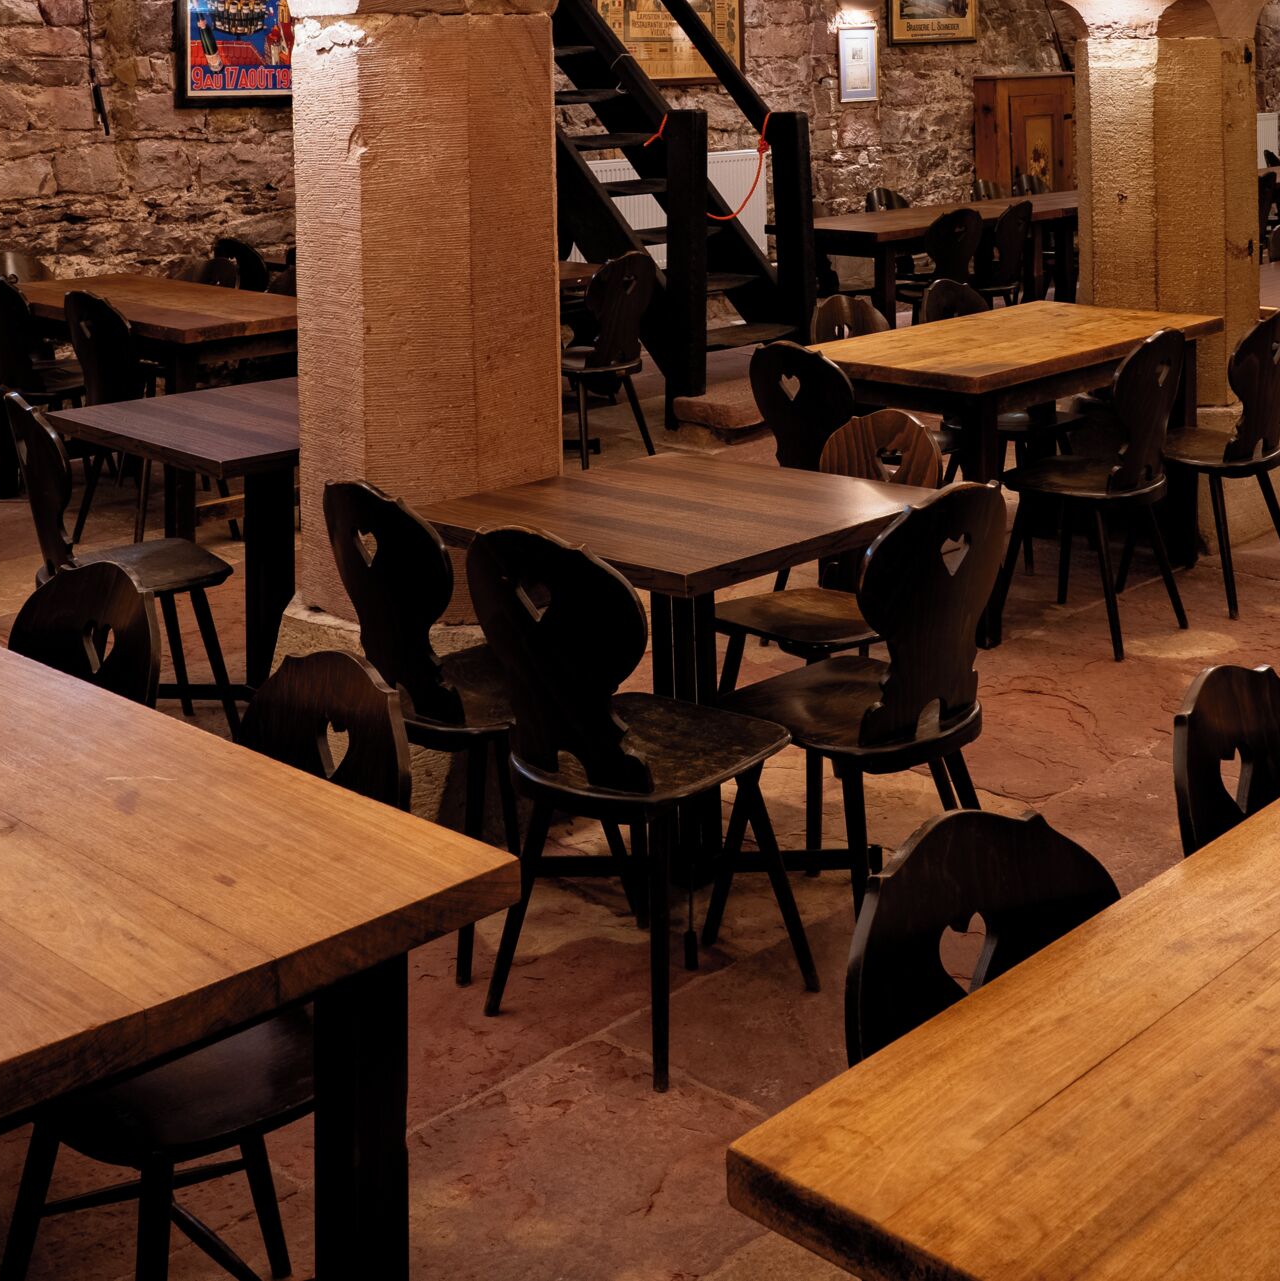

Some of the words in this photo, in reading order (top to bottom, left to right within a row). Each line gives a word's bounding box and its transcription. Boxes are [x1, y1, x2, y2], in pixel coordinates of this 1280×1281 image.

[192, 66, 204, 90] 9
[203, 73, 222, 90] AU
[225, 66, 239, 89] 17
